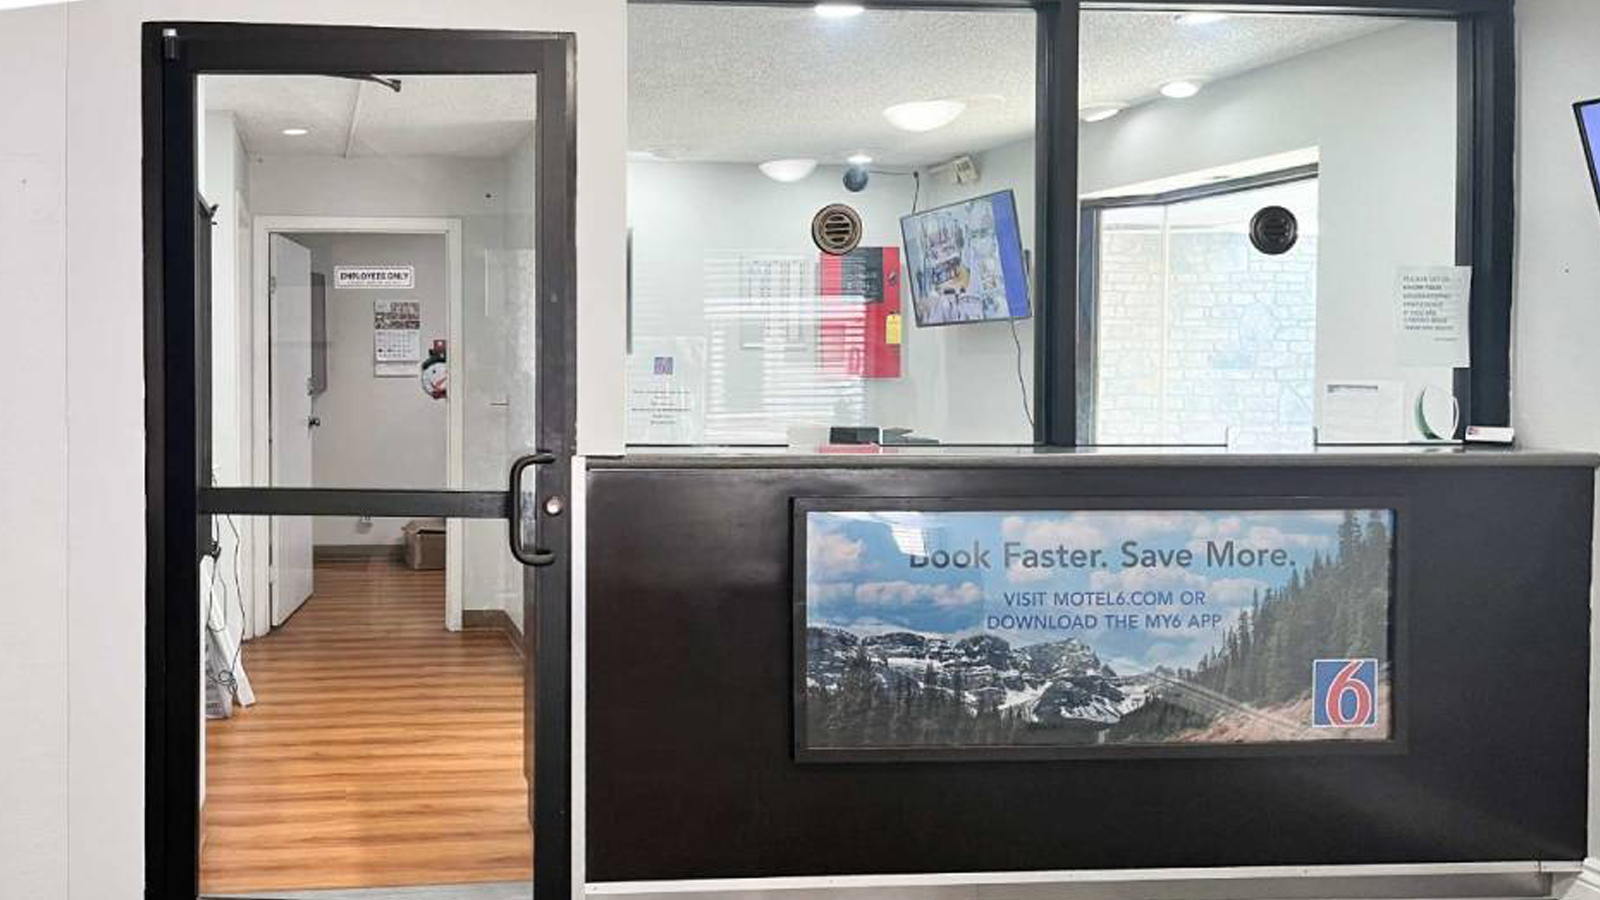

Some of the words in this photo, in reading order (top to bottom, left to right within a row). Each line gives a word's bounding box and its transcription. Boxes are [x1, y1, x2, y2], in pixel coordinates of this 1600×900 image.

[1004, 542, 1107, 568] Faster.
[1121, 541, 1193, 568] Save
[1207, 541, 1296, 567] More.
[1004, 592, 1047, 606] VISIT
[1054, 591, 1173, 606] MOTEL6.COM
[1181, 591, 1206, 605] OR
[987, 614, 1098, 629] DOWNLOAD
[1103, 614, 1139, 629] THE
[1145, 614, 1182, 628] MY6
[1188, 614, 1222, 628] APP
[1326, 659, 1372, 728] 6
